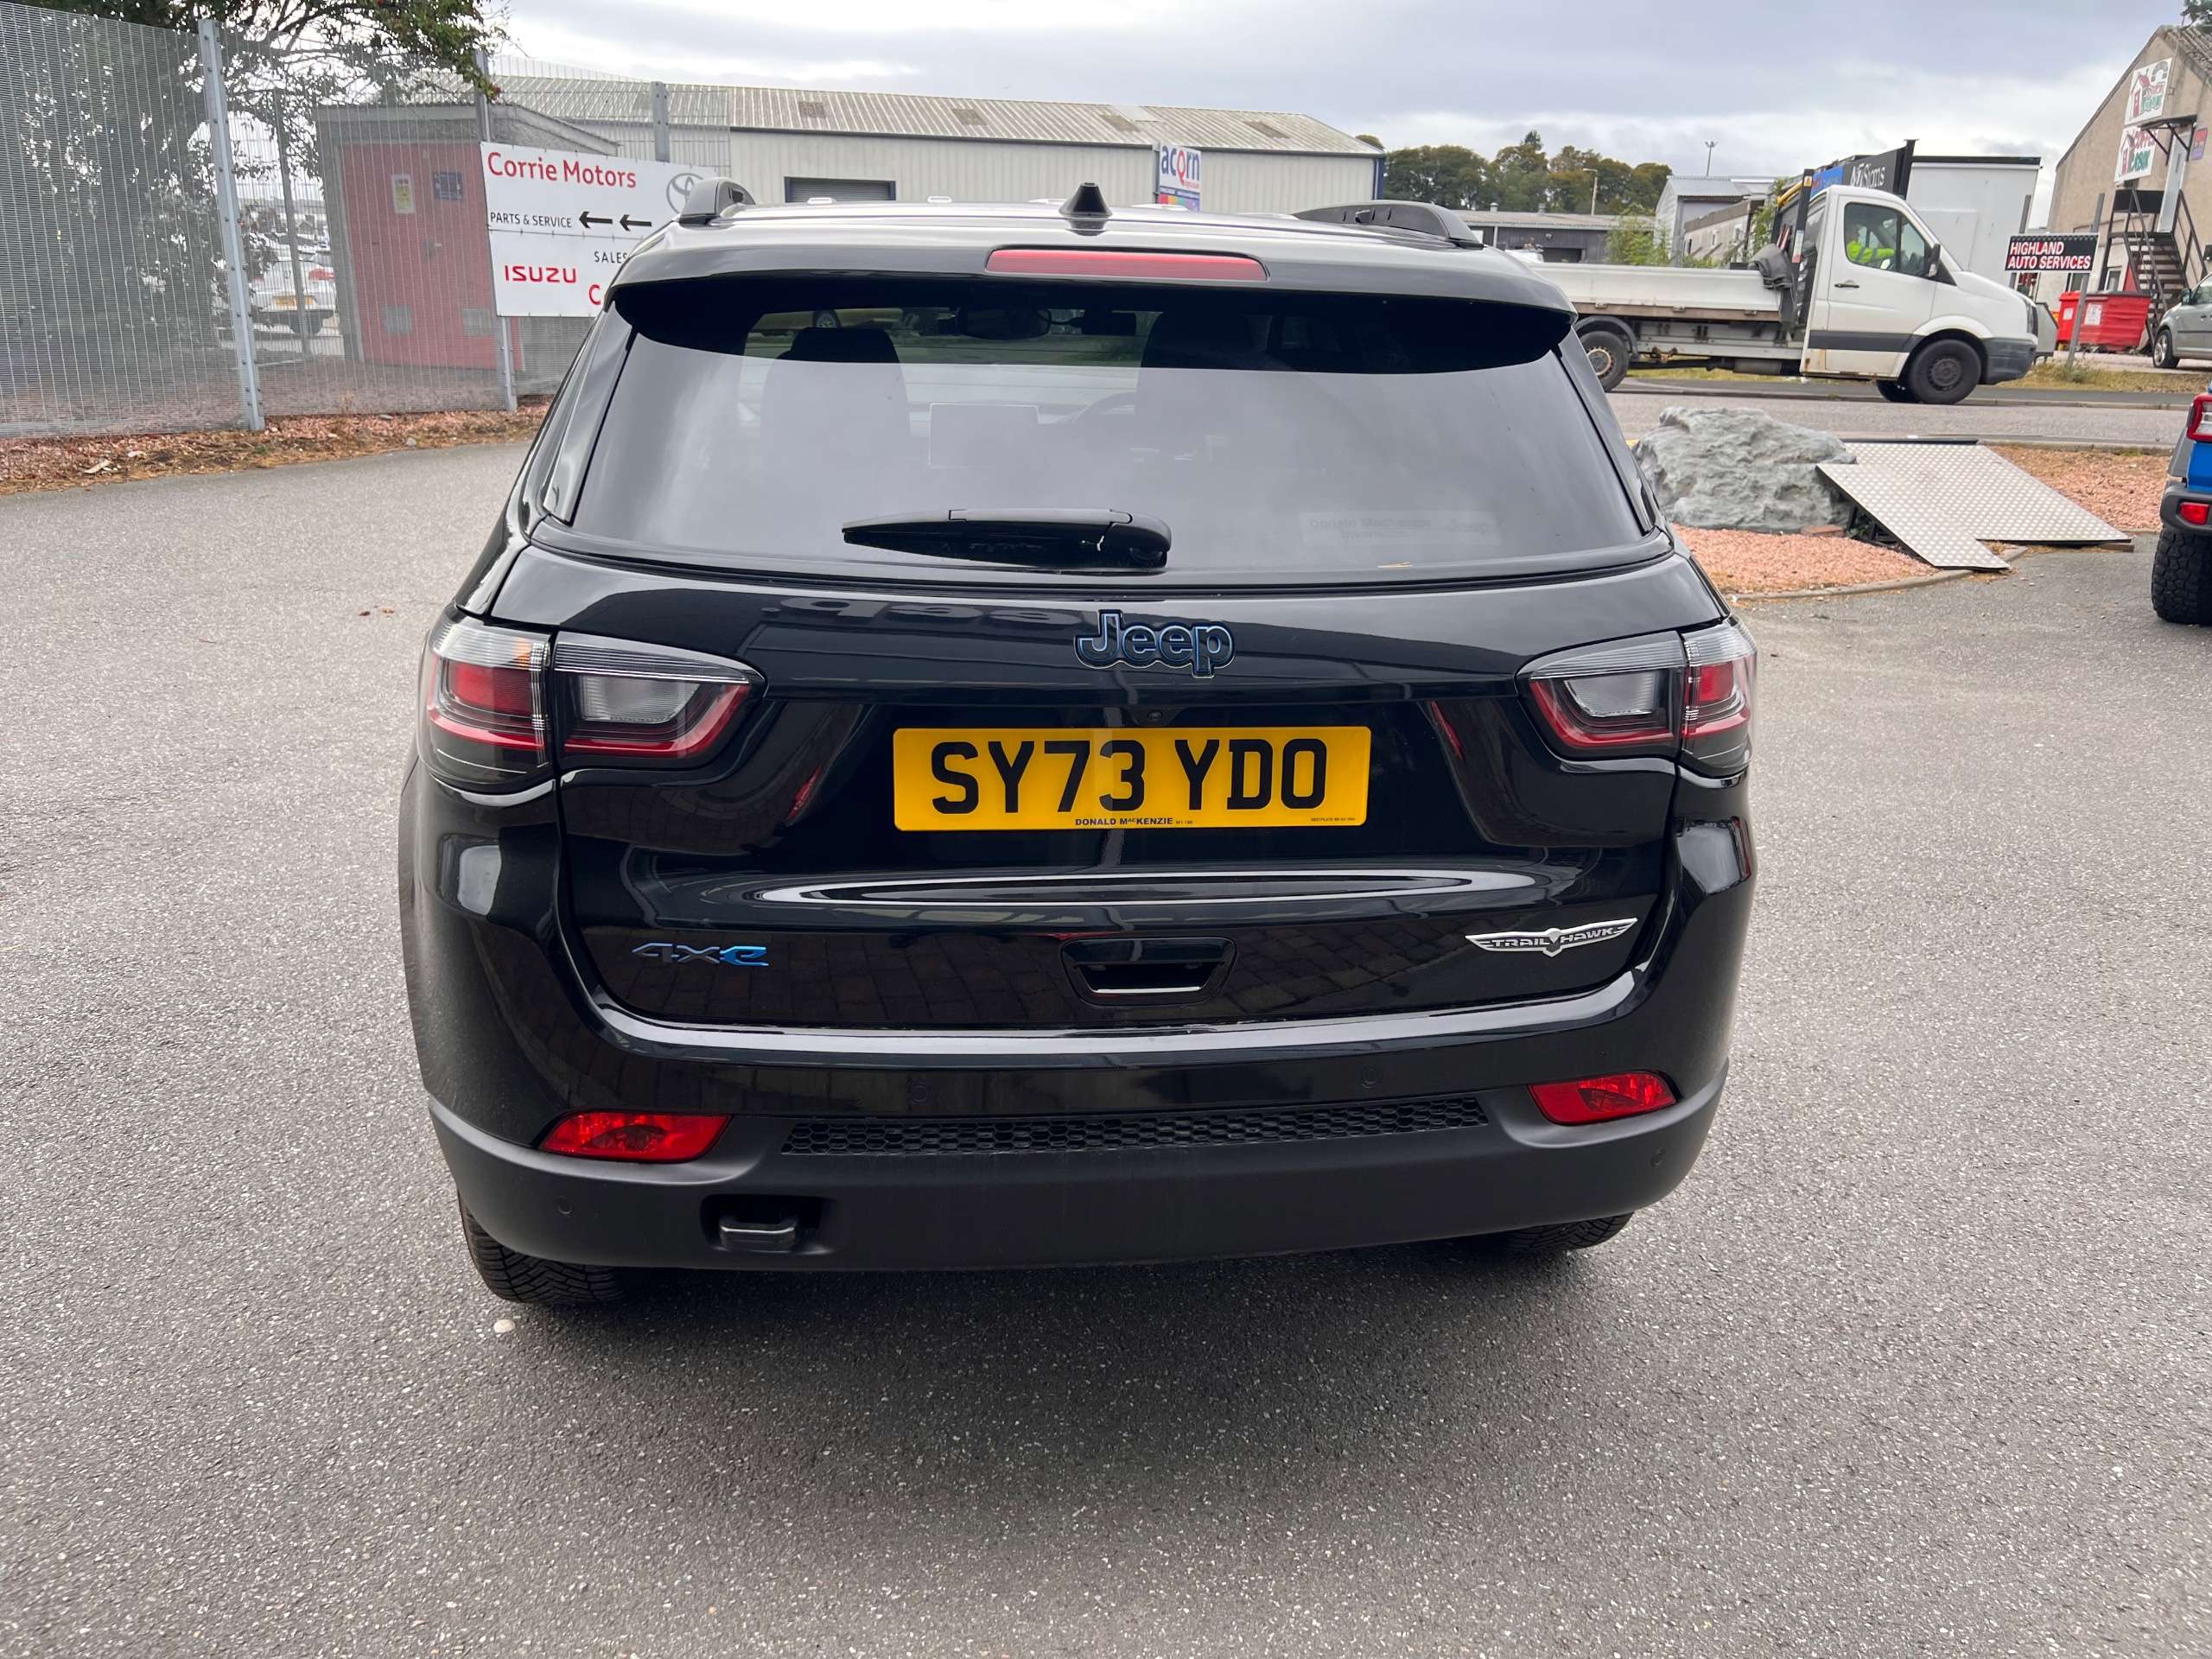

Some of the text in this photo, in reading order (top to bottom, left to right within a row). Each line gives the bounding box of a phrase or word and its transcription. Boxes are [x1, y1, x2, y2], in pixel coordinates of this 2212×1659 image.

[487, 151, 637, 188] Corrie Motors
[1161, 145, 1200, 183] acorn
[490, 212, 573, 228] PARTS & SERVICE
[2010, 241, 2065, 256] HIGHLAND
[2007, 256, 2092, 270] AUTO SERVICES
[504, 264, 577, 283] ISUZU
[1076, 611, 1235, 677] Jeep
[931, 738, 1328, 814] SY73 YDO
[1075, 817, 1116, 826] DONALD
